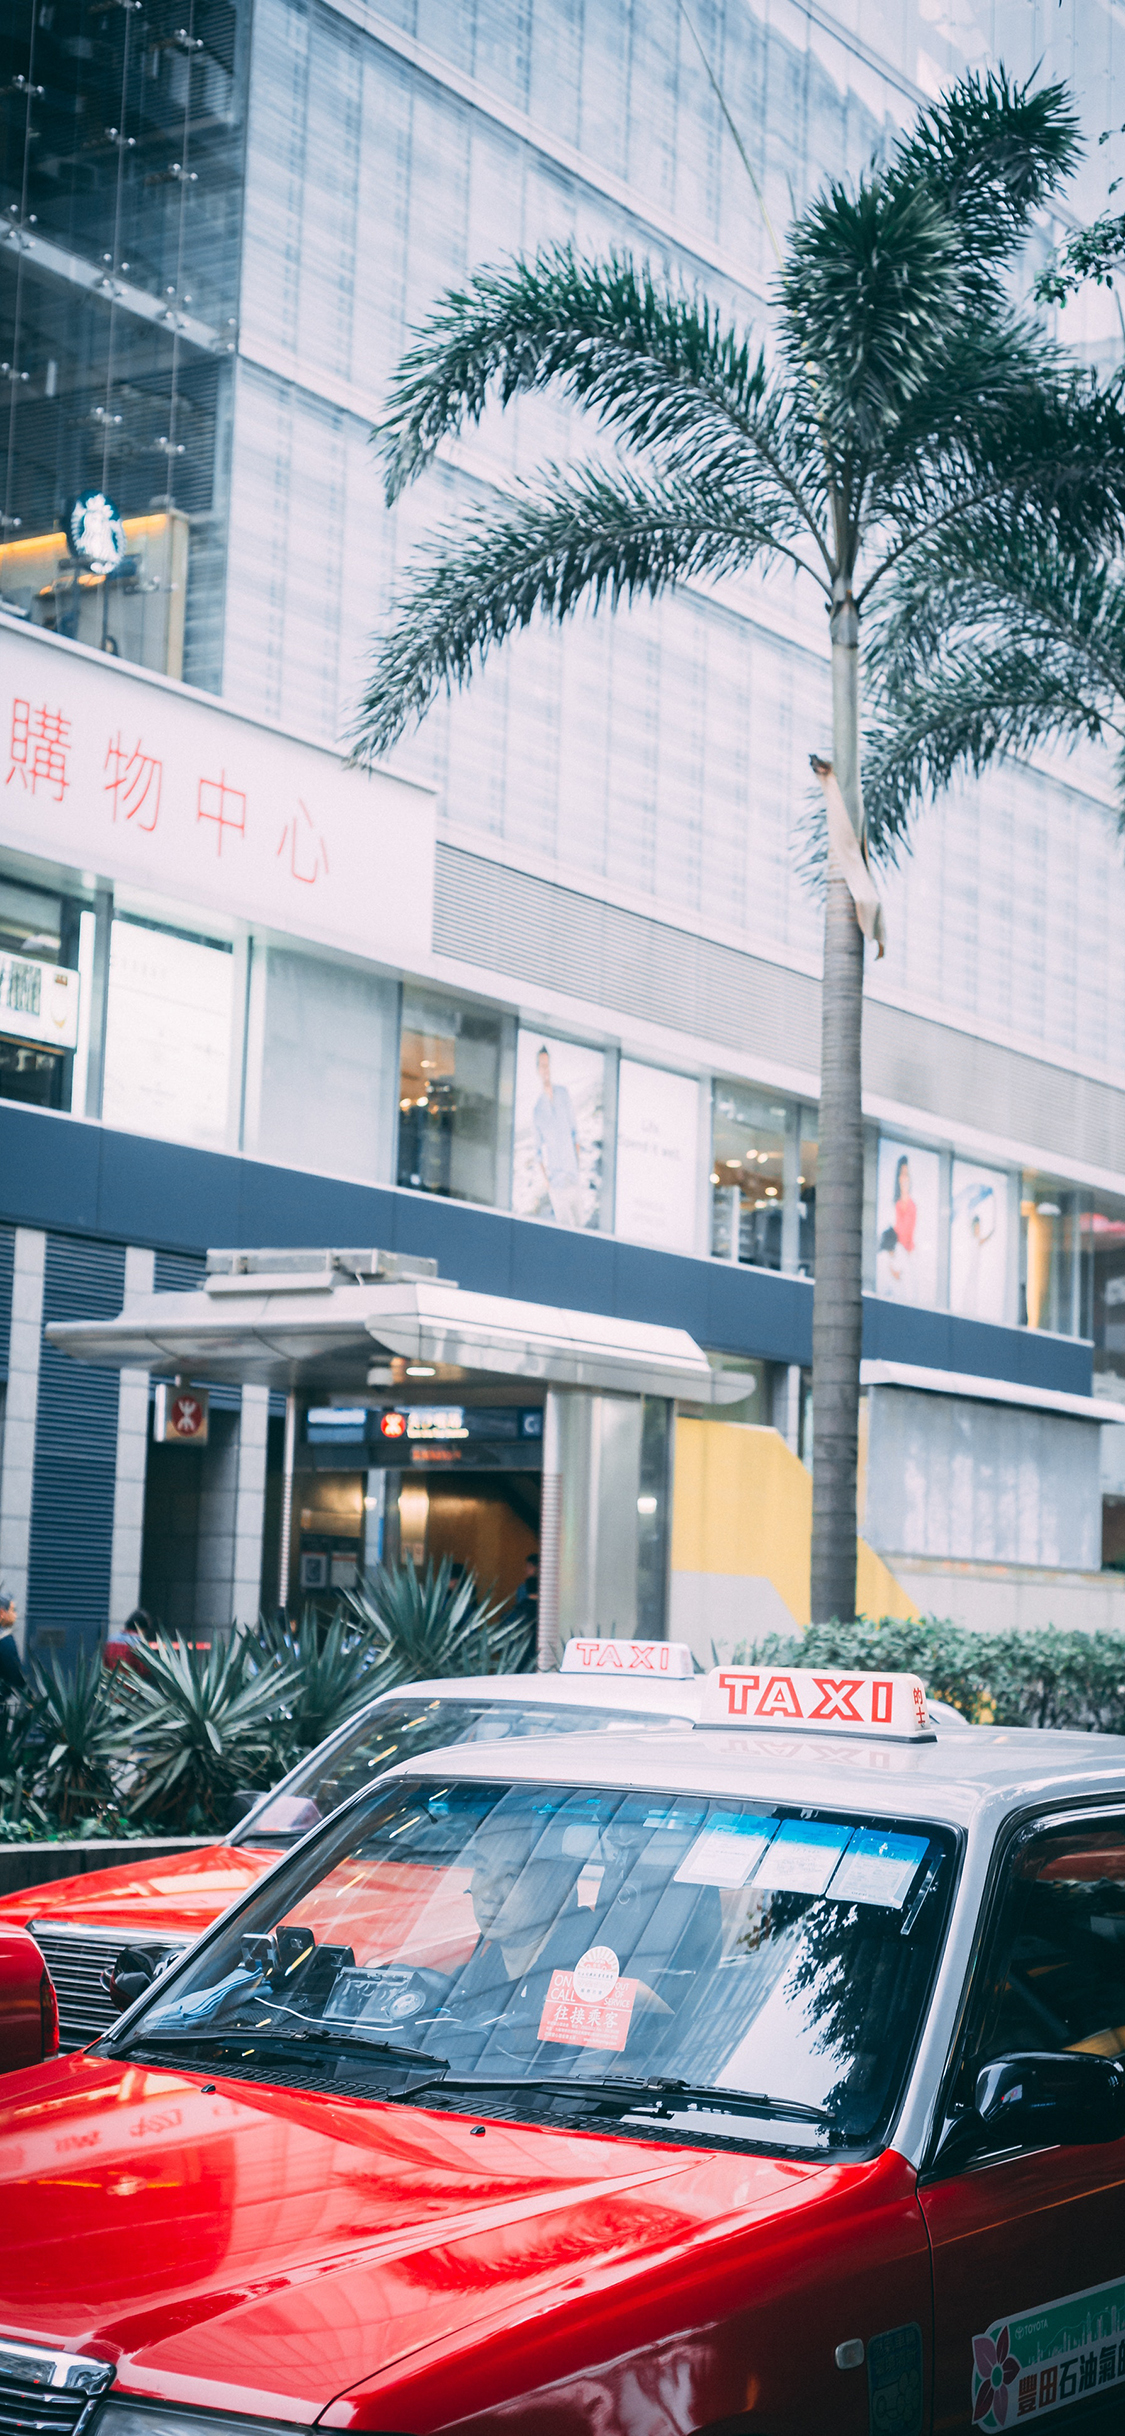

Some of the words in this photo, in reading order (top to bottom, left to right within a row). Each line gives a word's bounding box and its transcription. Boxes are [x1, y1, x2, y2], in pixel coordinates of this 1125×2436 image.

[5, 697, 330, 884] 購物中心
[576, 1642, 670, 1671] TAXI
[718, 1673, 894, 1724] TAXI
[913, 1687, 926, 1724] 的士
[554, 1974, 572, 1988] ON
[615, 1982, 629, 1991] OUT
[550, 1988, 576, 2002] CALL
[603, 1997, 631, 2008] SERVICE
[615, 1990, 625, 1999] OF
[553, 2004, 619, 2028] 往接乘客
[1023, 2319, 1049, 2336] TOYOTA
